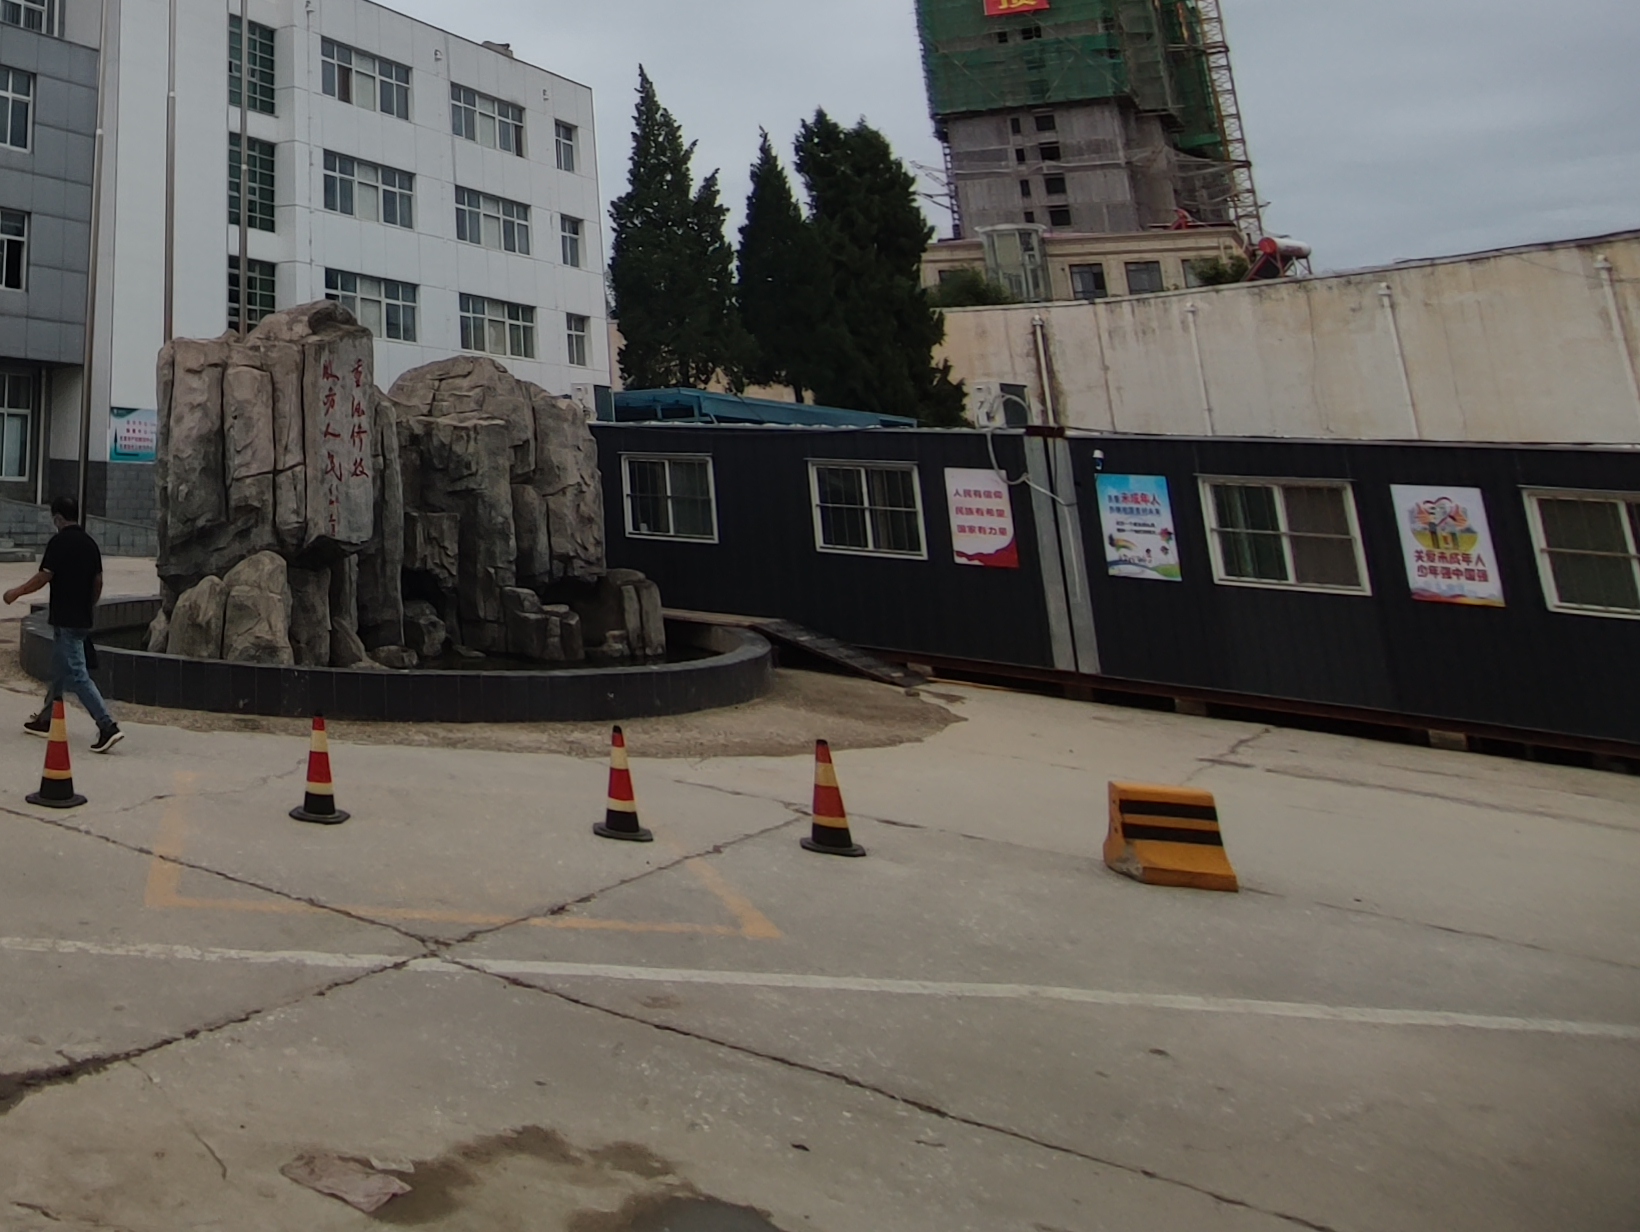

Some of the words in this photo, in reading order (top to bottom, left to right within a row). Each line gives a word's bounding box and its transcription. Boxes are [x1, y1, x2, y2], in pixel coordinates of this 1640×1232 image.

[953, 488, 1003, 499] 人民有信仰
[955, 506, 1006, 518] 民族有希望
[956, 524, 1008, 536] 国家有力量
[1414, 549, 1486, 567] 关爱未成年人
[1417, 565, 1489, 582] 少年强中国强
